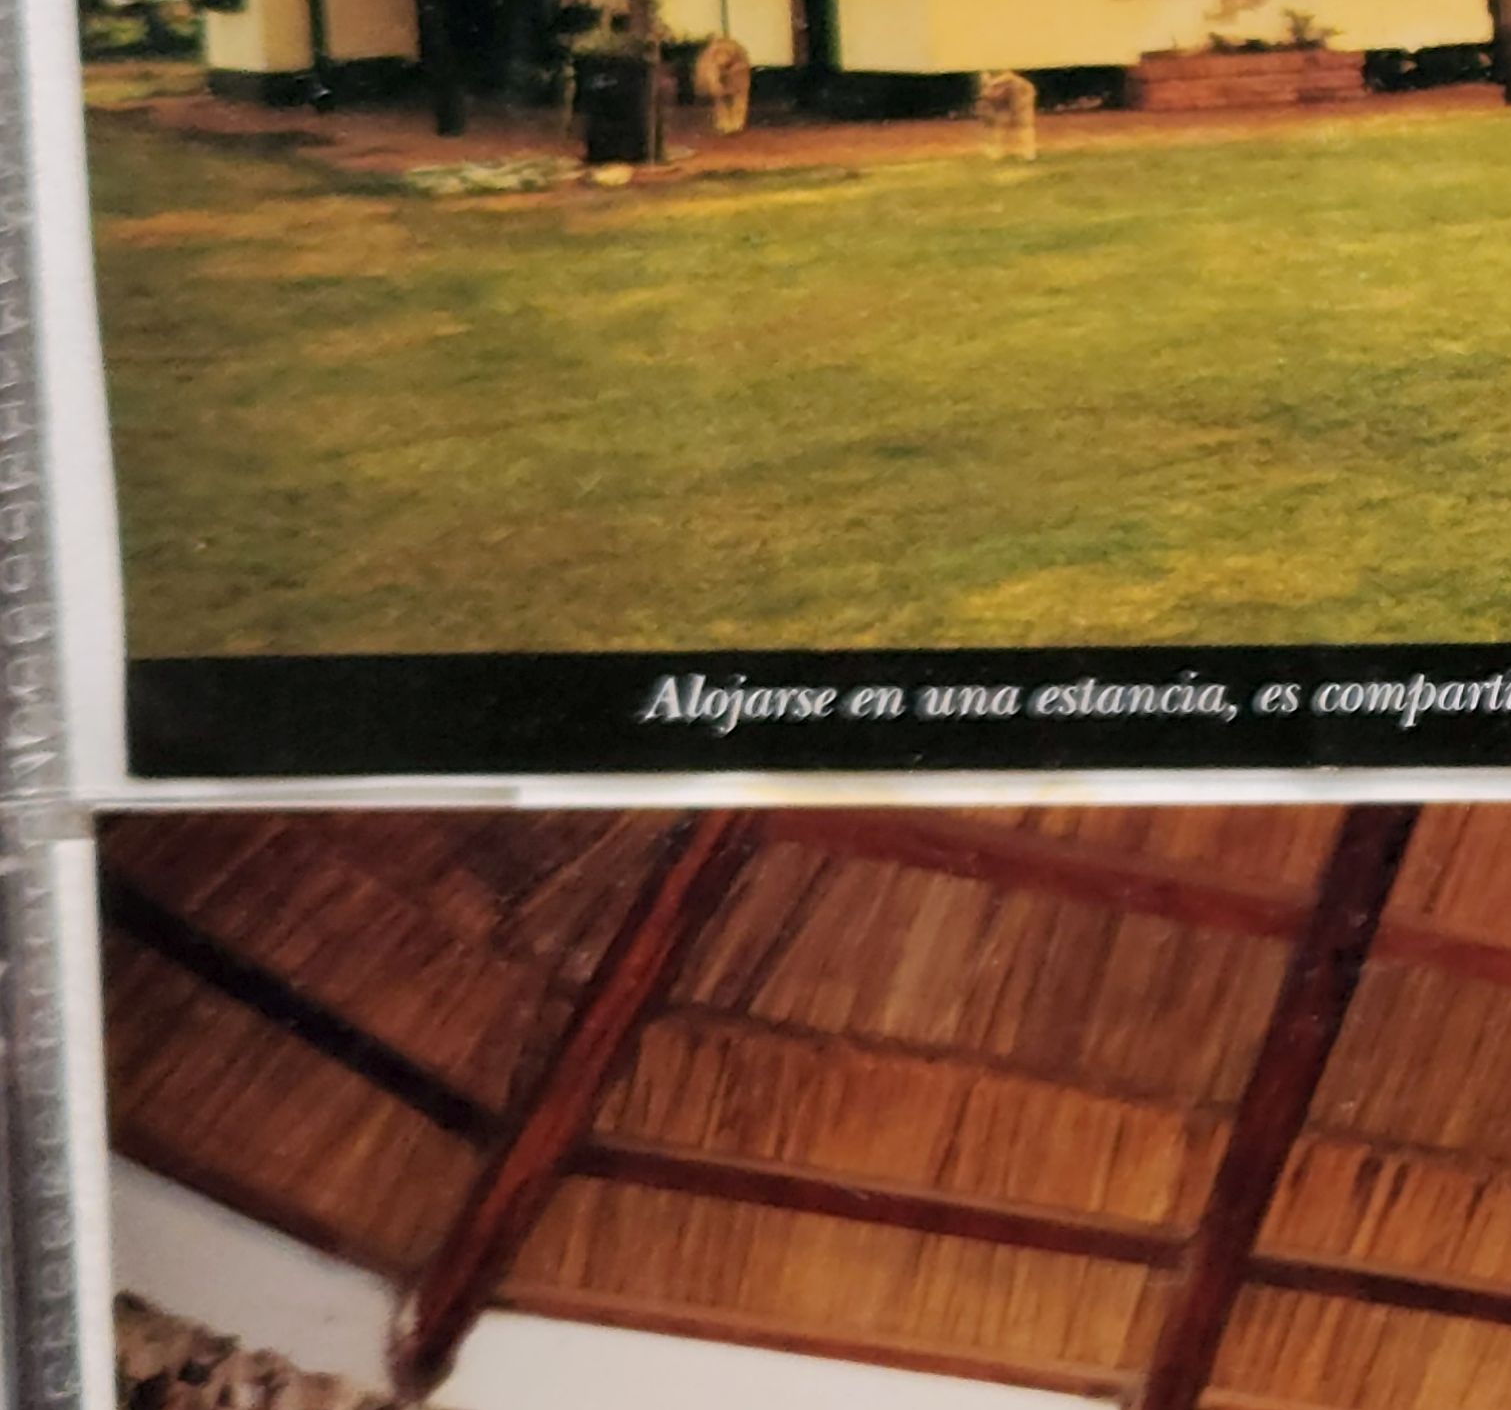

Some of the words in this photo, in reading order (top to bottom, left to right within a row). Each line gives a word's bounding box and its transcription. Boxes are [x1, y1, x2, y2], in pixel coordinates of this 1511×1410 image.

[645, 675, 836, 732] Alojarse
[850, 688, 902, 716] en
[924, 686, 1019, 715] una
[1036, 673, 1237, 720] estancia,
[1260, 684, 1300, 712] es
